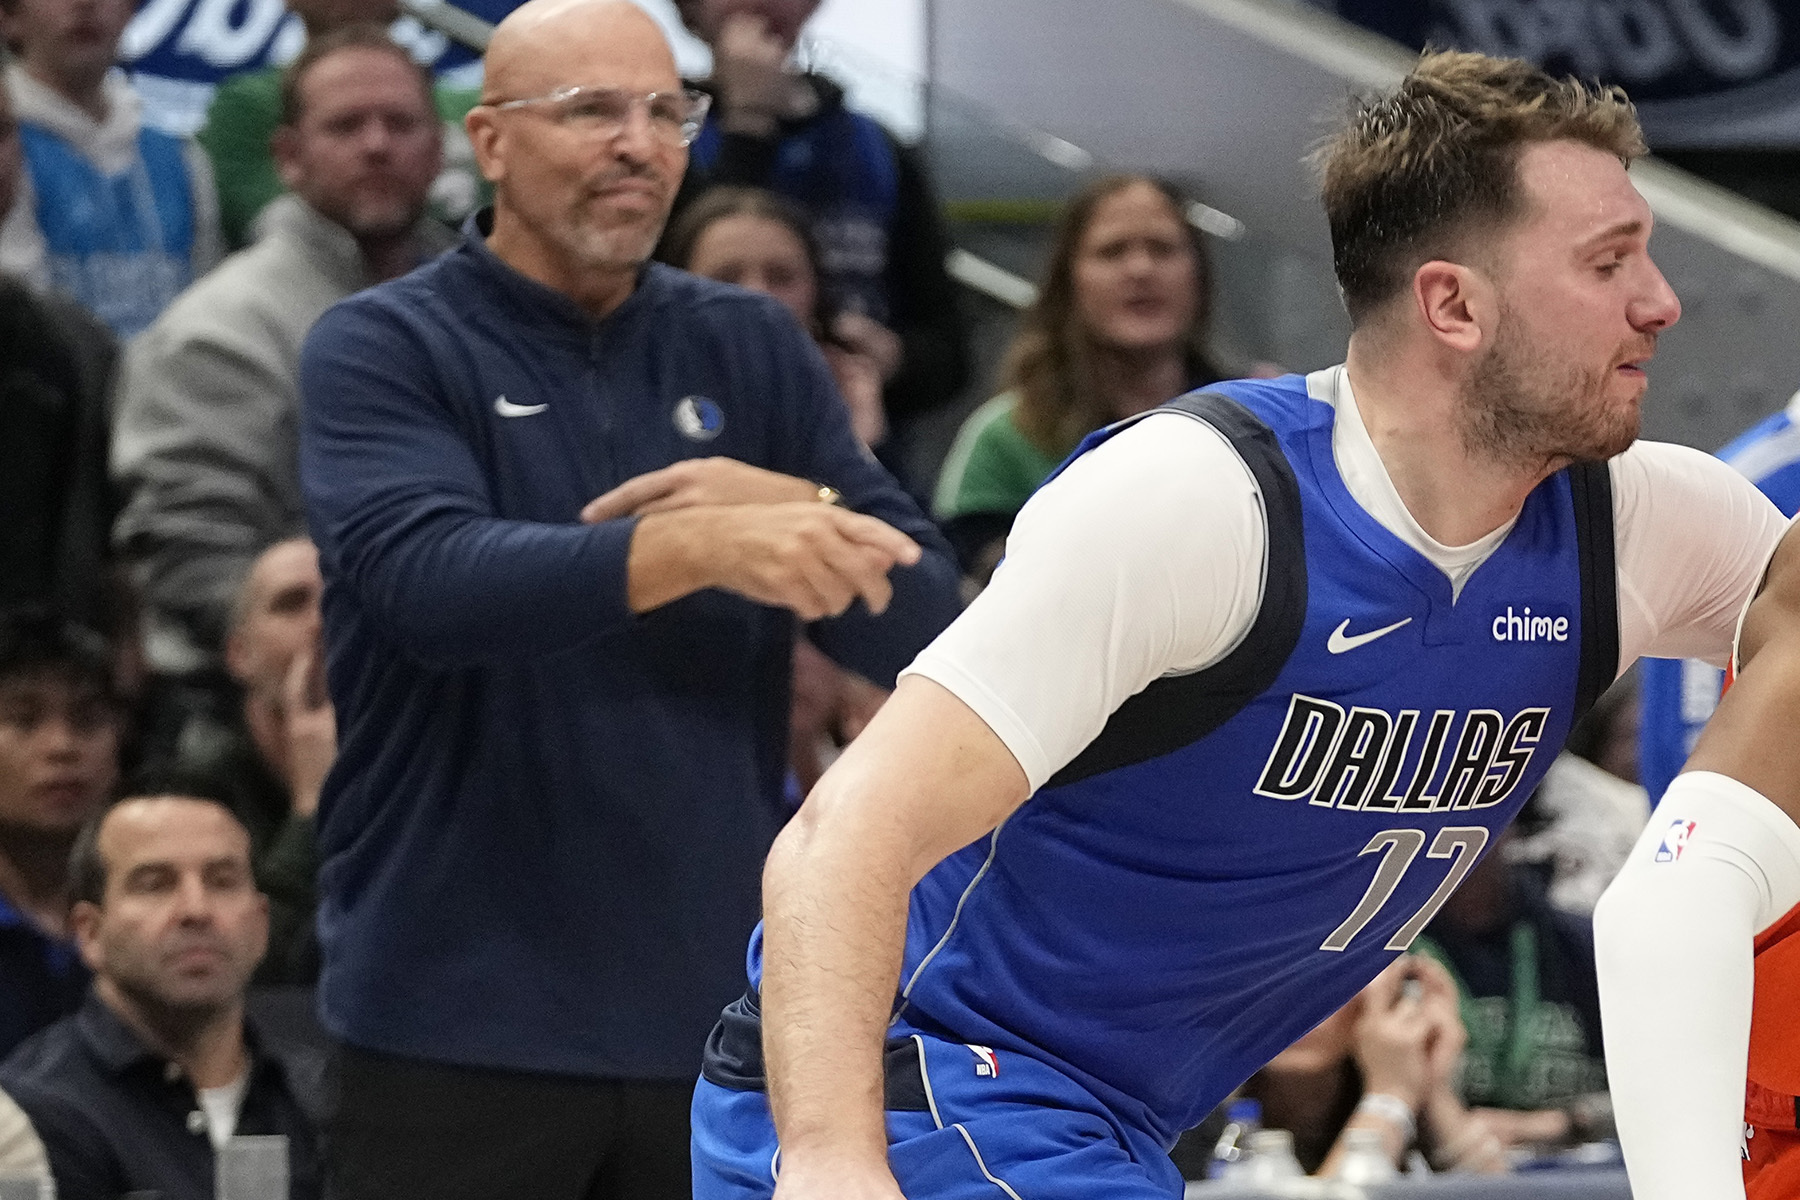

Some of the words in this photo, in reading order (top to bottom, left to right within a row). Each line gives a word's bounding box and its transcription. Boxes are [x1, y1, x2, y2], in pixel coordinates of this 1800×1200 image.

[1492, 607, 1568, 642] chime
[1253, 693, 1551, 813] DALLAS
[1318, 826, 1490, 952] 77
